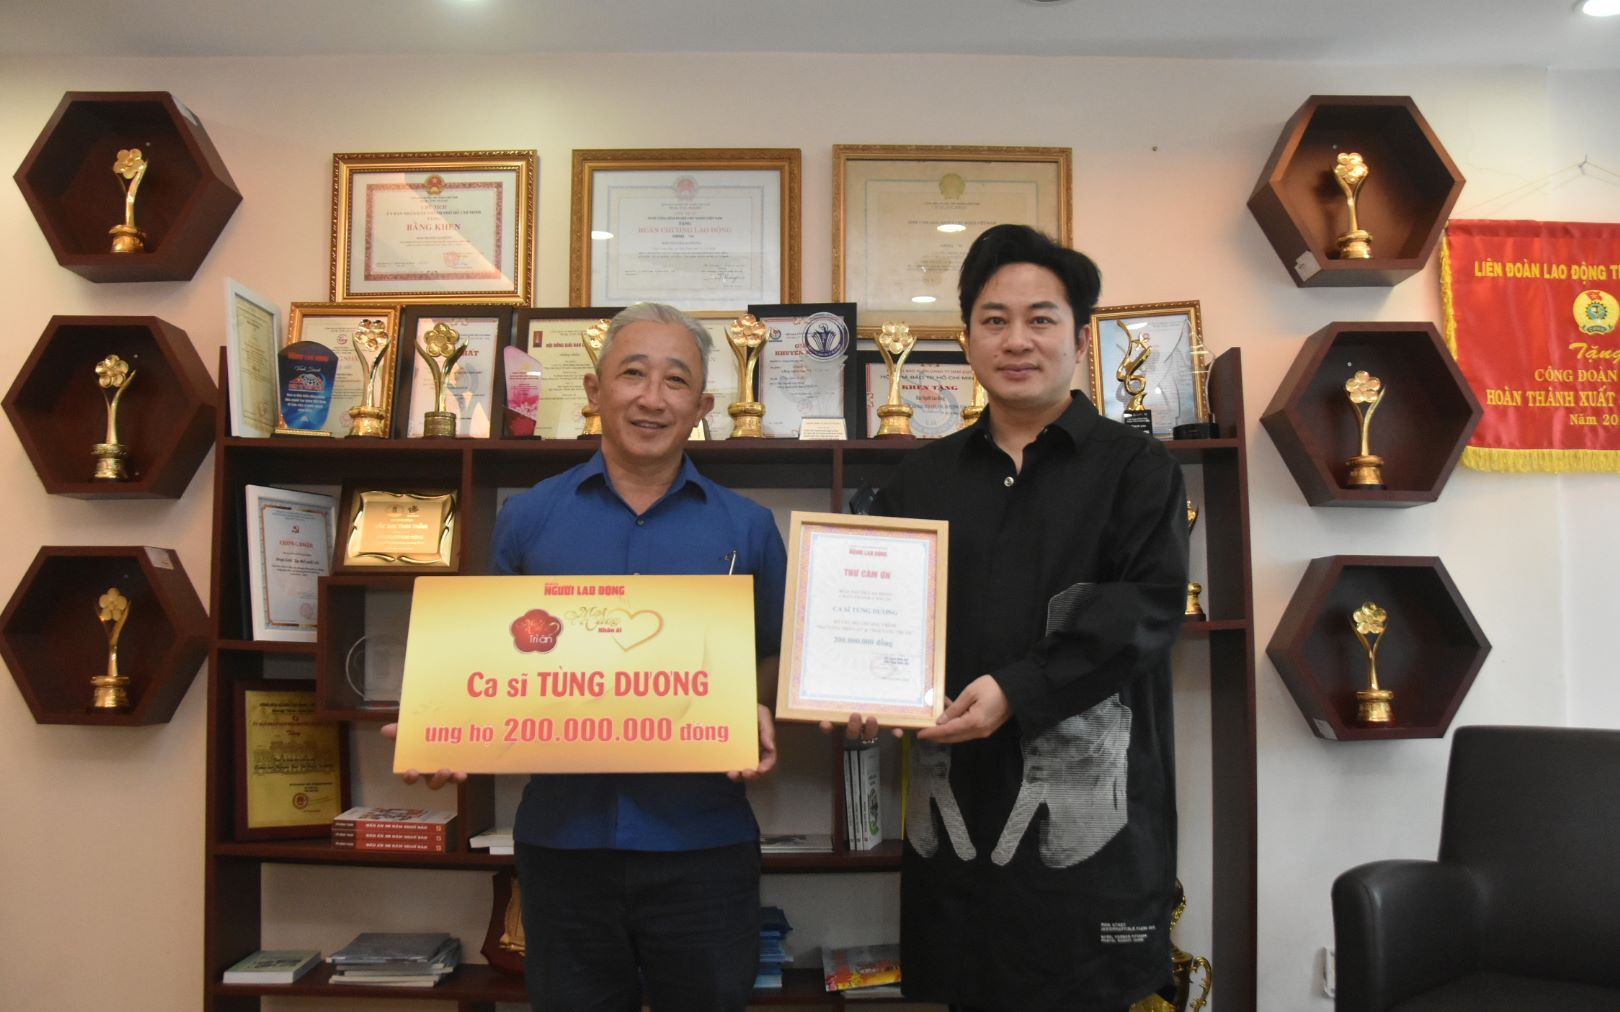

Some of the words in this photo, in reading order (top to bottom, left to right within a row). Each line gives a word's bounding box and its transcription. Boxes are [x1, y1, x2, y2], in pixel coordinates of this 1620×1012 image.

[1474, 257, 1503, 277] LIÊN
[1505, 258, 1540, 278] ĐOÀN
[1543, 263, 1568, 279] LAO
[1571, 261, 1607, 285] ĐỘNG
[1534, 365, 1575, 382] CÔNG
[1578, 366, 1618, 382] ĐOÀN
[1486, 385, 1522, 406] HOÀN
[1526, 386, 1576, 407] THÀNH
[1579, 385, 1616, 407] XUẤT
[1569, 413, 1598, 425] Năm
[1602, 414, 1620, 425] 20
[467, 671, 498, 698] Ca
[507, 673, 528, 698] sĩ
[537, 665, 605, 698] TÙNG
[614, 670, 709, 697] DƯƠNG
[503, 717, 673, 742] 200.000.000
